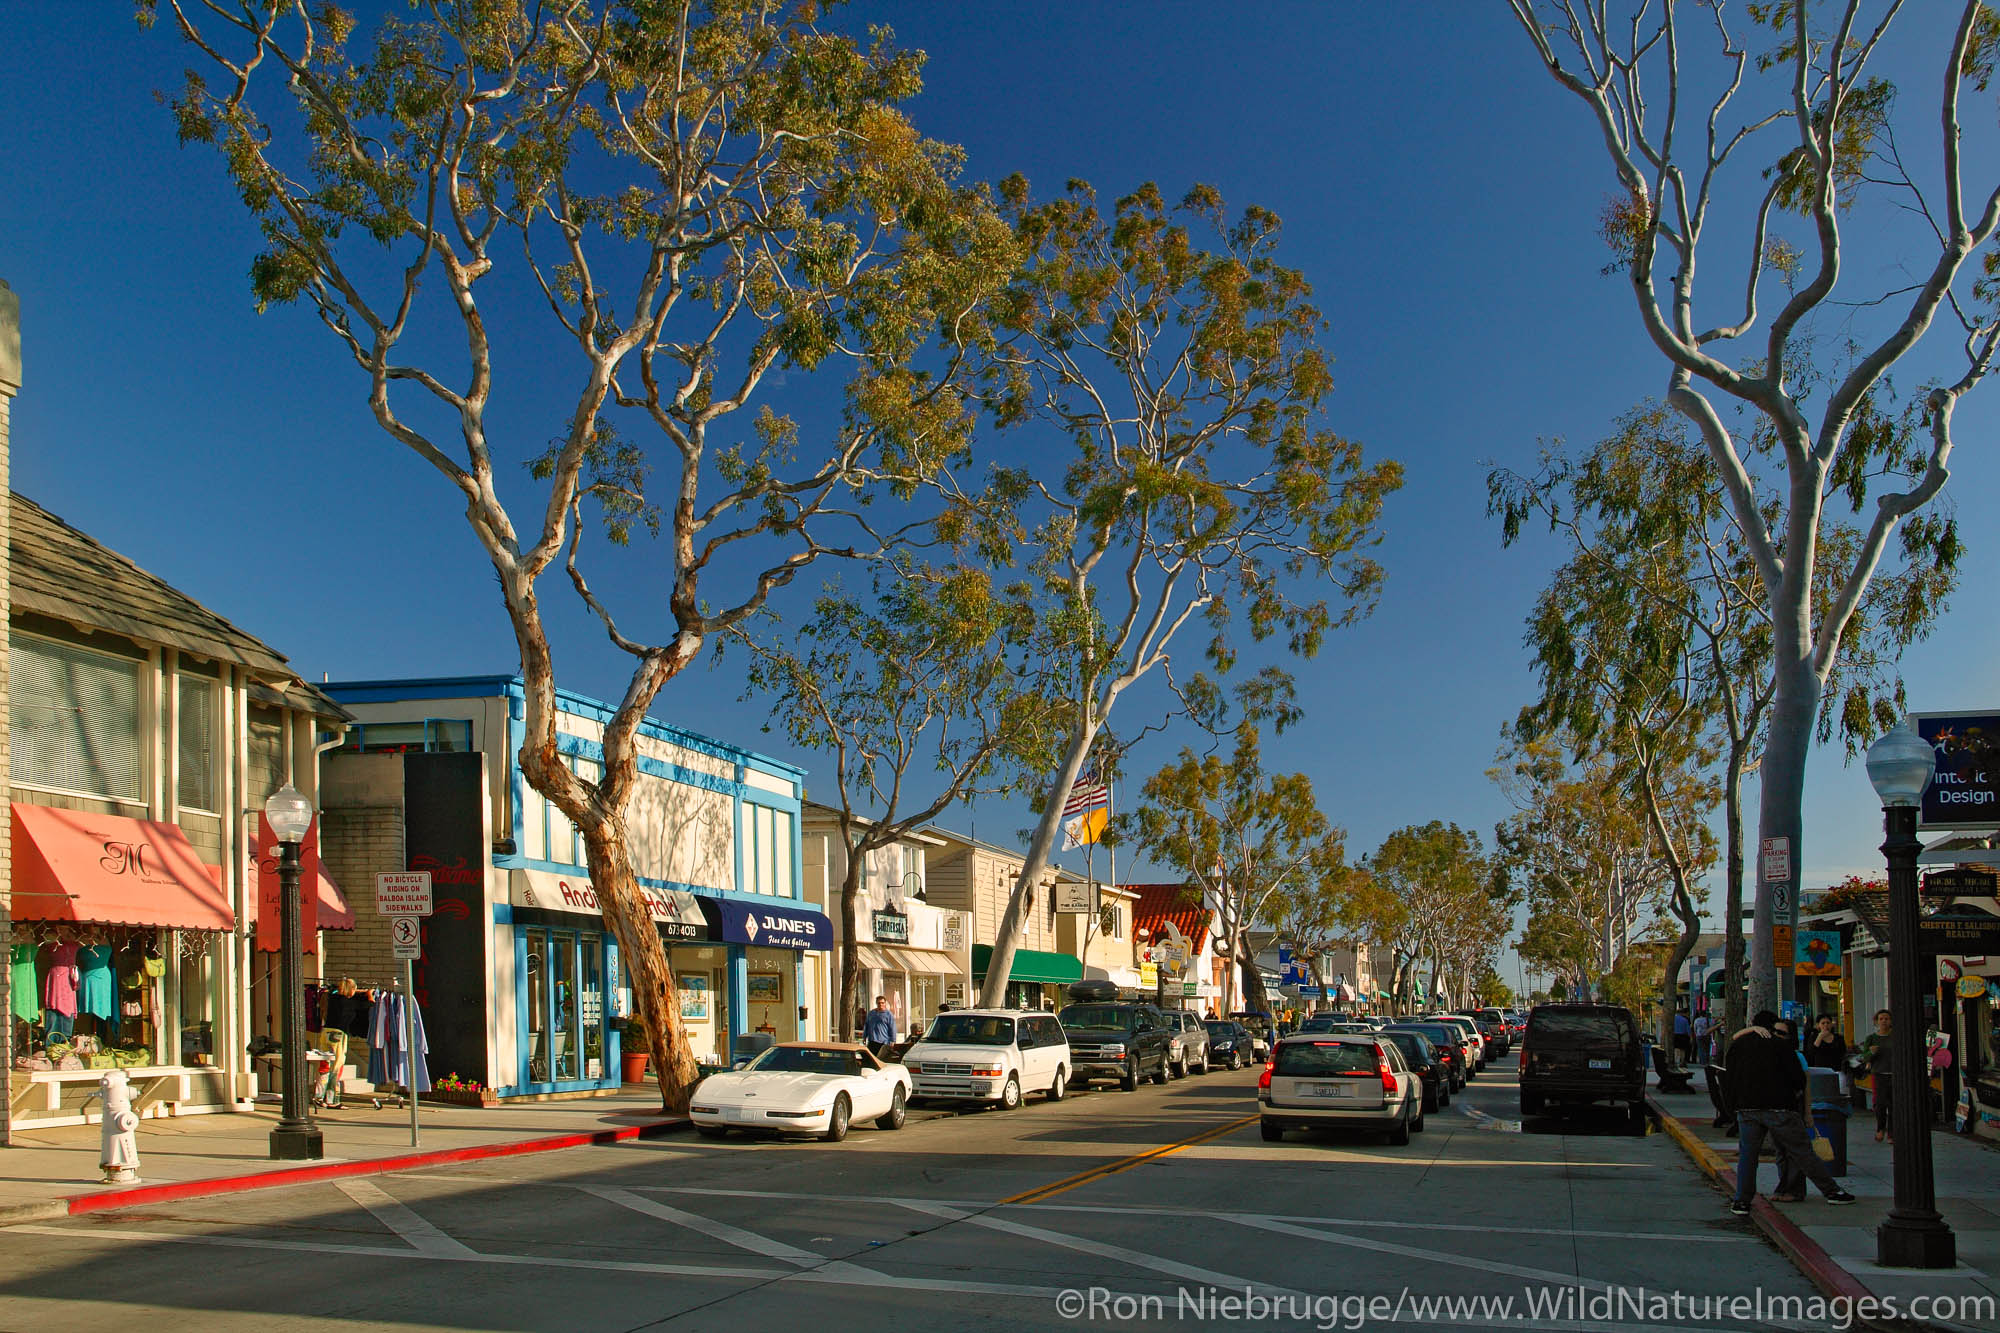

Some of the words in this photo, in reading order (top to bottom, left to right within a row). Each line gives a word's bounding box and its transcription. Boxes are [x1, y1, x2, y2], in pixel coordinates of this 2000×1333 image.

[1940, 789, 1995, 804] Design
[1763, 840, 1773, 850] NO
[1764, 849, 1788, 857] PARKING
[386, 885, 409, 893] RIDING
[379, 894, 404, 902] BALBOA
[405, 894, 429, 902] ISLAND
[641, 886, 682, 918] Hair!
[668, 924, 680, 935] 673
[680, 925, 697, 937] 4013
[762, 915, 816, 935] JUNE'S
[768, 934, 780, 945] Fine
[780, 936, 791, 945] Art
[791, 937, 811, 949] Gallery
